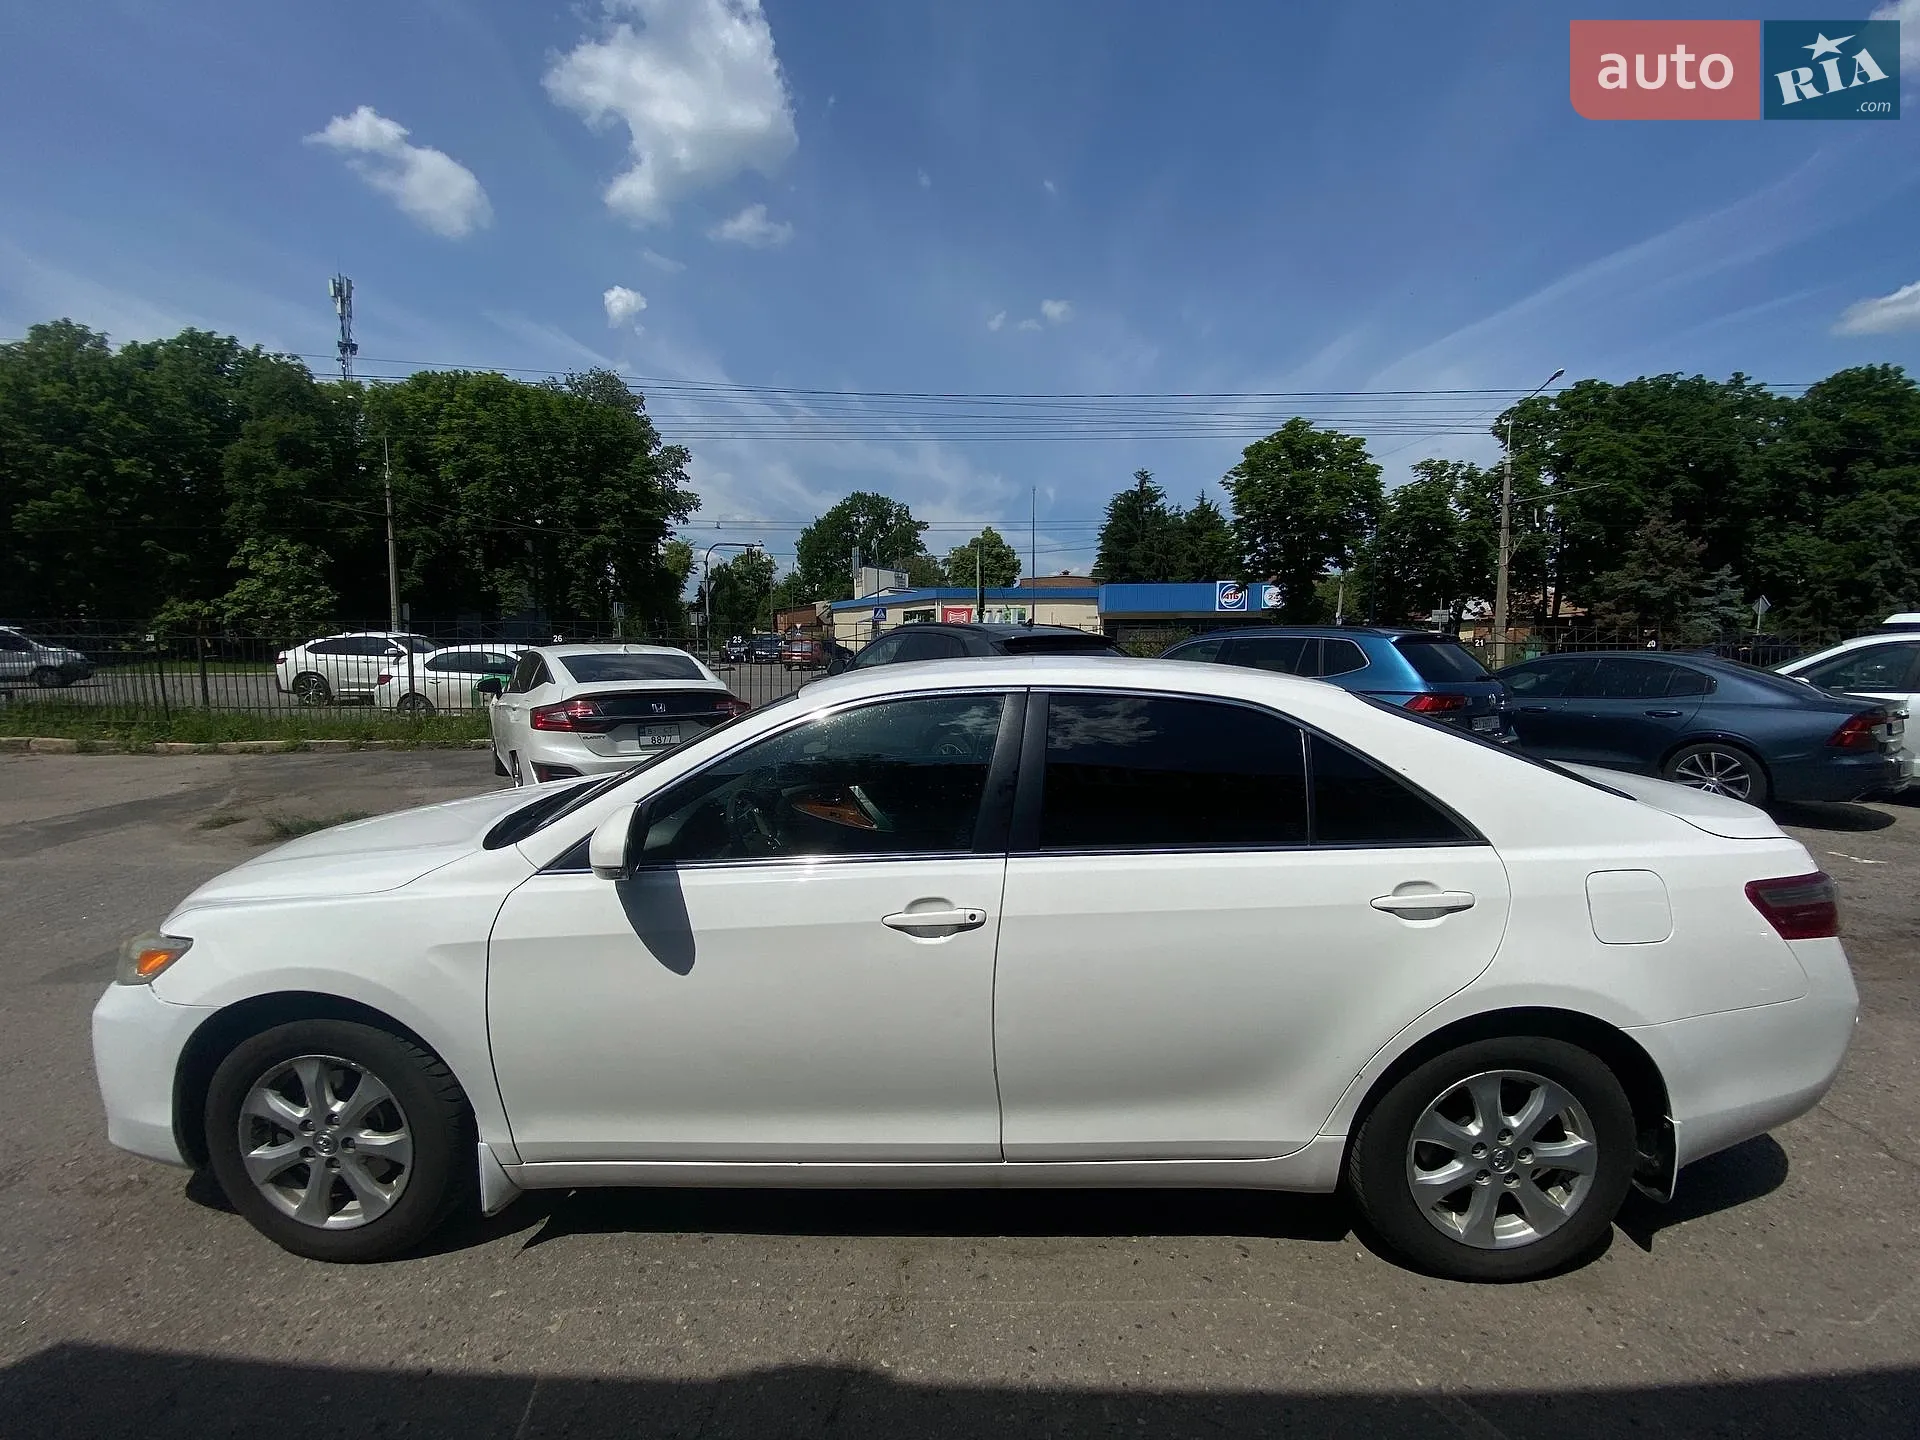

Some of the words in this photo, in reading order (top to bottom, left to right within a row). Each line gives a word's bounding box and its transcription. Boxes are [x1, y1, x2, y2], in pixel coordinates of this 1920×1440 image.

[552, 634, 563, 643] 26
[732, 635, 742, 644] 25
[1474, 639, 1484, 647] 21
[651, 735, 672, 745] 8877
